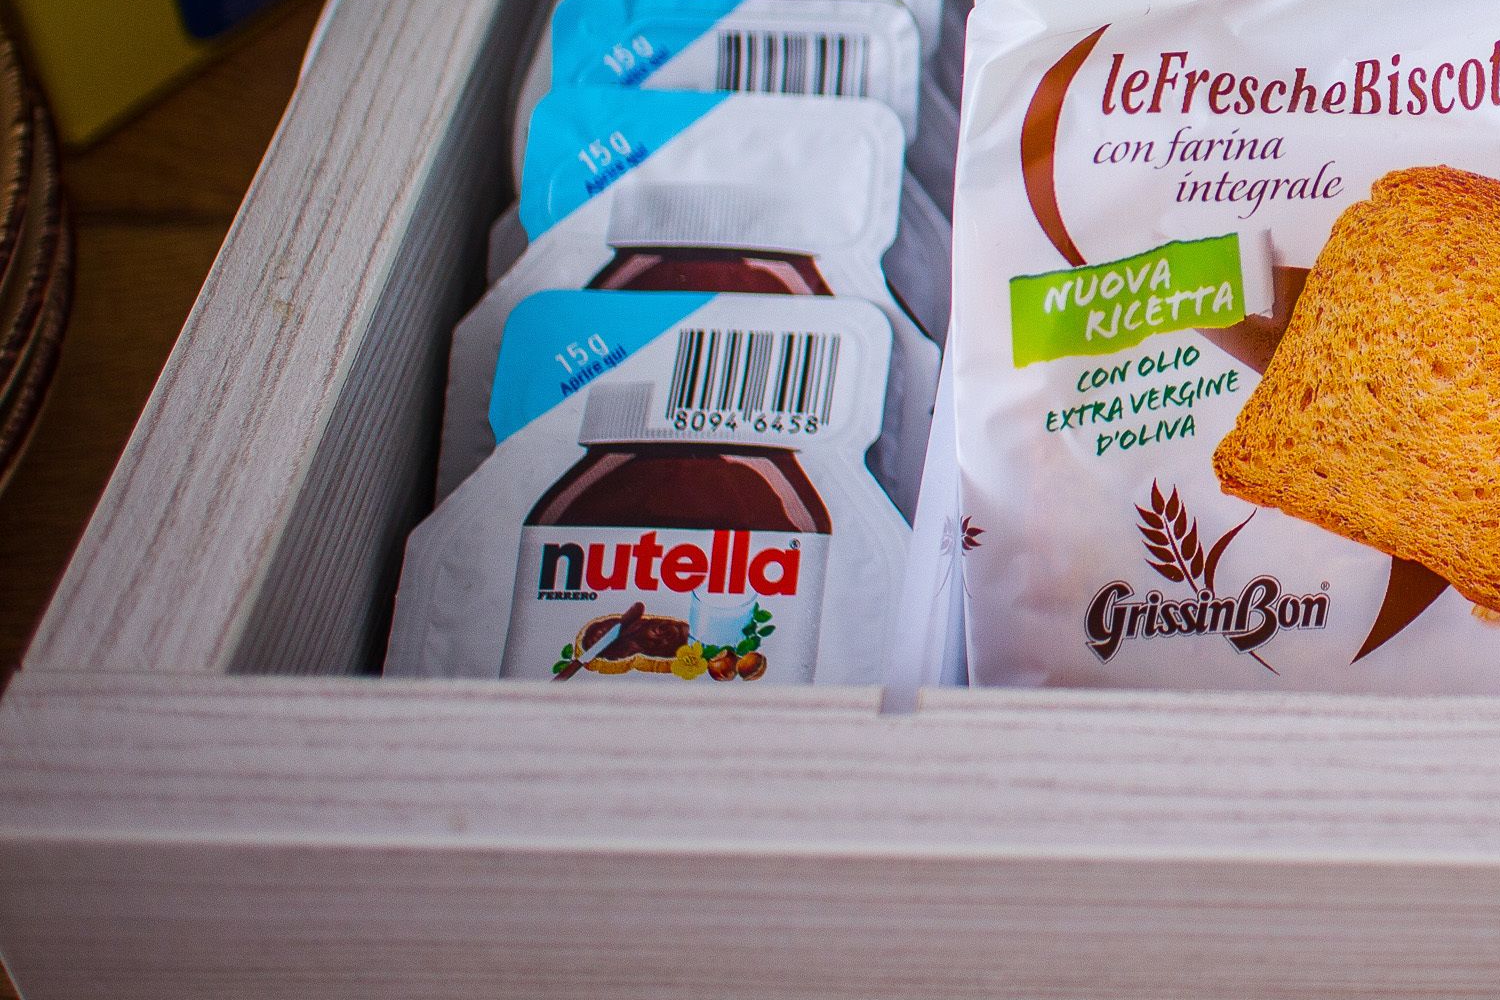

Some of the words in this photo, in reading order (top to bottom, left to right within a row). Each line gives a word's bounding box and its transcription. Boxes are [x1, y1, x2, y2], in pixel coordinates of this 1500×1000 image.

[1093, 138, 1157, 165] con
[1153, 126, 1287, 170] farina
[1175, 160, 1345, 220] integrale
[1044, 258, 1171, 315] NUOVA
[1085, 281, 1234, 342] RICETTA
[558, 360, 602, 399] Aprire
[603, 342, 628, 369] qui
[1077, 360, 1132, 393] CON
[1137, 345, 1201, 378] OLIO
[674, 409, 738, 433] 8094
[753, 412, 820, 435] 6458
[1046, 396, 1124, 433] EXTRA
[1129, 369, 1240, 414] VERGINE
[1096, 414, 1196, 457] D'OLIVA
[538, 530, 800, 596] nutella
[537, 591, 598, 600] FERRERO
[1084, 574, 1330, 665] GrissinBon
